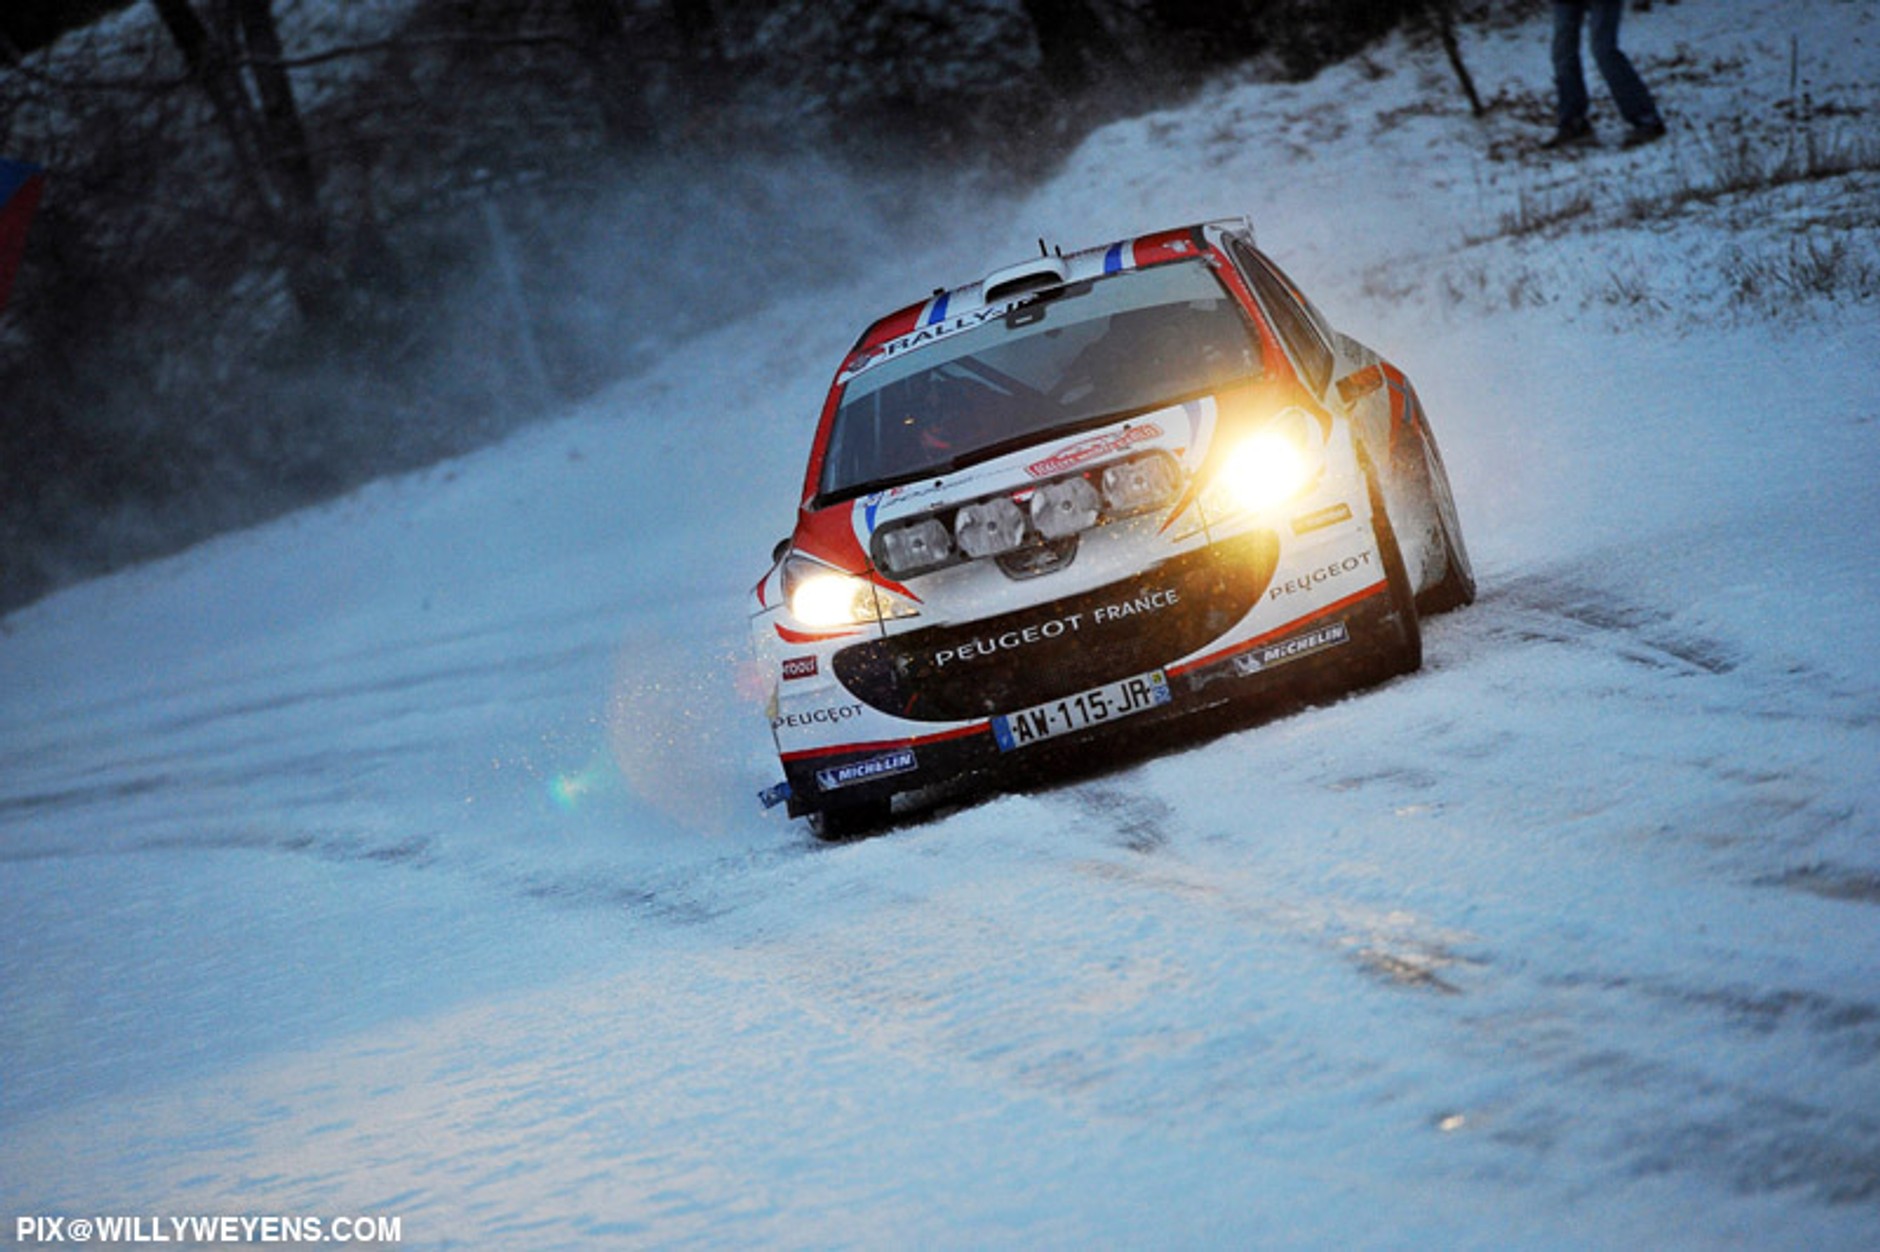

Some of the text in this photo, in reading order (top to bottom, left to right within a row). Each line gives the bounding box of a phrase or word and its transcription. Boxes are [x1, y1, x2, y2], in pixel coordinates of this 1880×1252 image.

[1269, 551, 1372, 600] PEUGEOT
[935, 589, 1180, 666] PEUGEOT FRANCE
[1263, 626, 1344, 662] MICHELIN
[772, 704, 863, 729] PEUGEOT
[838, 754, 911, 781] MICHELIN
